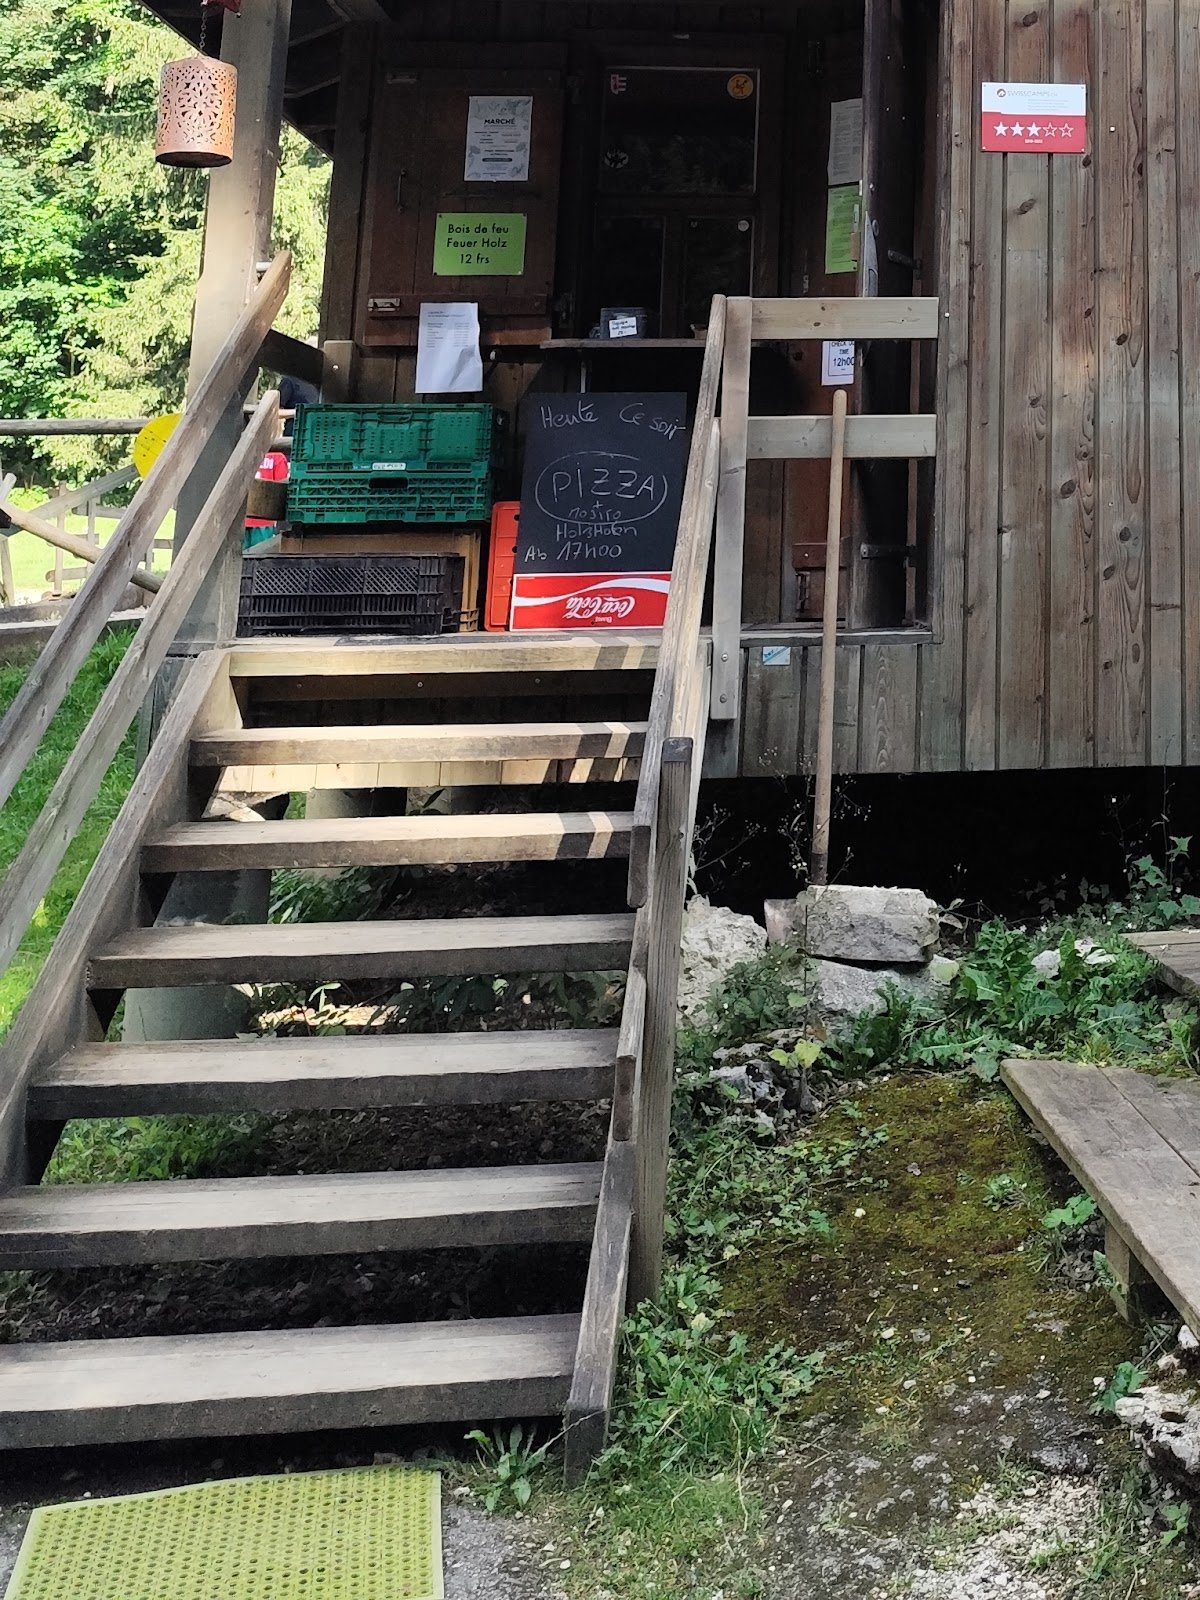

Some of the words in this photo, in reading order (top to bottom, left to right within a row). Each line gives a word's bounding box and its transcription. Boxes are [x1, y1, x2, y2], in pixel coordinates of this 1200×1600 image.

[448, 223, 470, 234] Bois
[474, 223, 487, 234] de
[491, 223, 509, 234] feu
[446, 238, 477, 248] Feuer
[481, 237, 507, 248] Holz
[460, 253, 472, 264] 12
[476, 253, 490, 264] frs
[541, 400, 598, 429] Heute
[619, 403, 645, 425] Ce
[524, 546, 547, 562] Ab
[556, 541, 622, 560] 17h00
